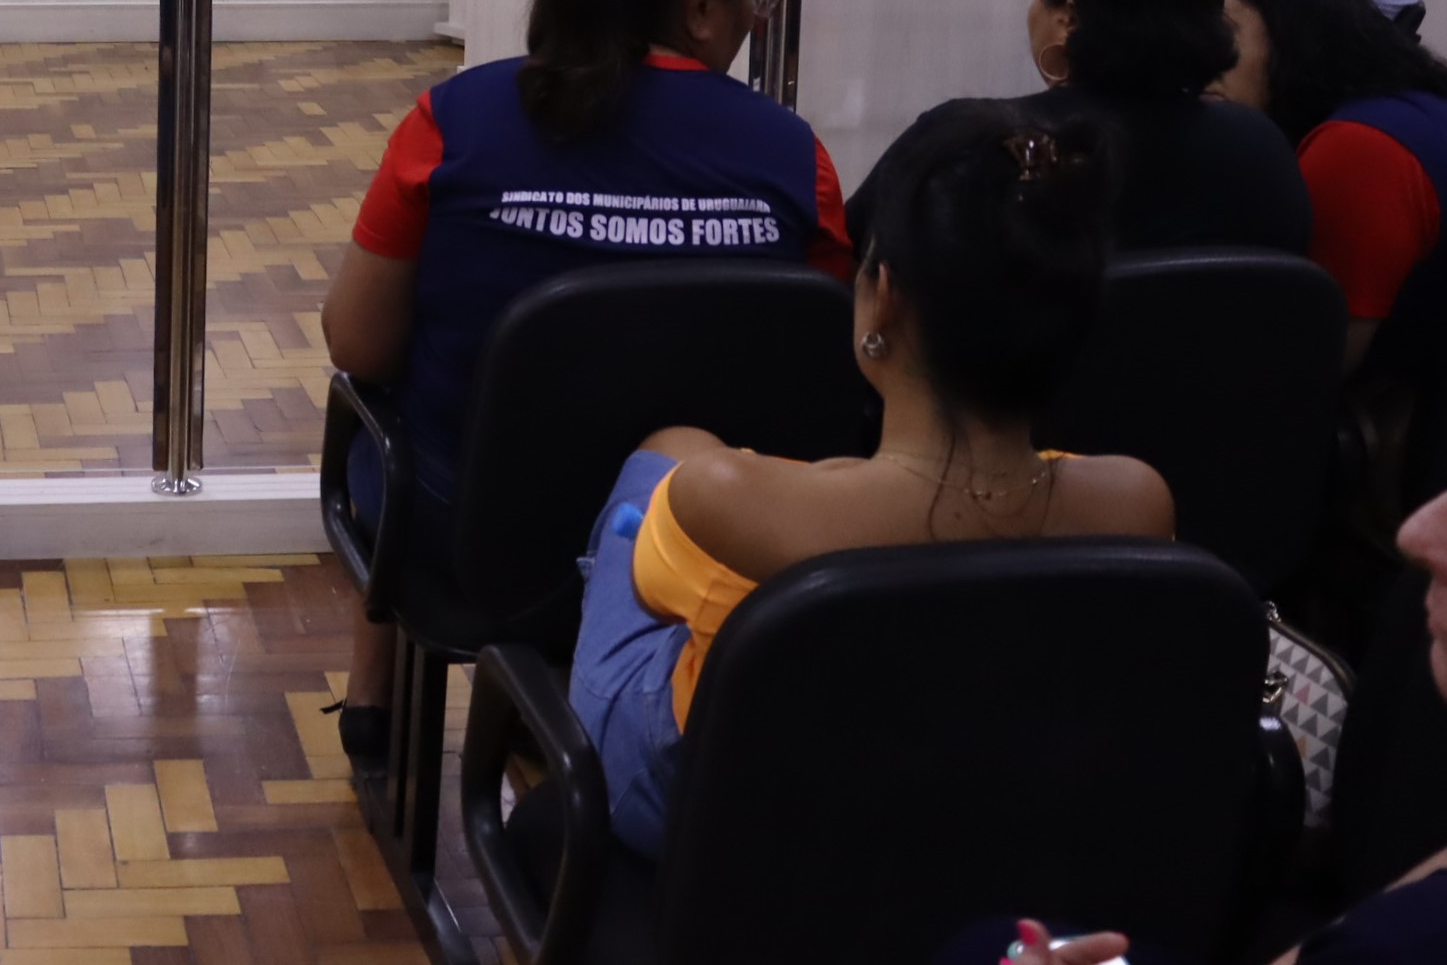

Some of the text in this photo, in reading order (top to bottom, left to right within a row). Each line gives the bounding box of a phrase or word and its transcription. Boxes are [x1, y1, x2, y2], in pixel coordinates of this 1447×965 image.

[502, 191, 564, 203] SINDICATO
[566, 192, 590, 206] DOS
[593, 194, 679, 211] MUNICIPÁRIOS
[681, 197, 696, 211] DE
[590, 213, 684, 245] SOMOS
[692, 217, 779, 245] FORTES
